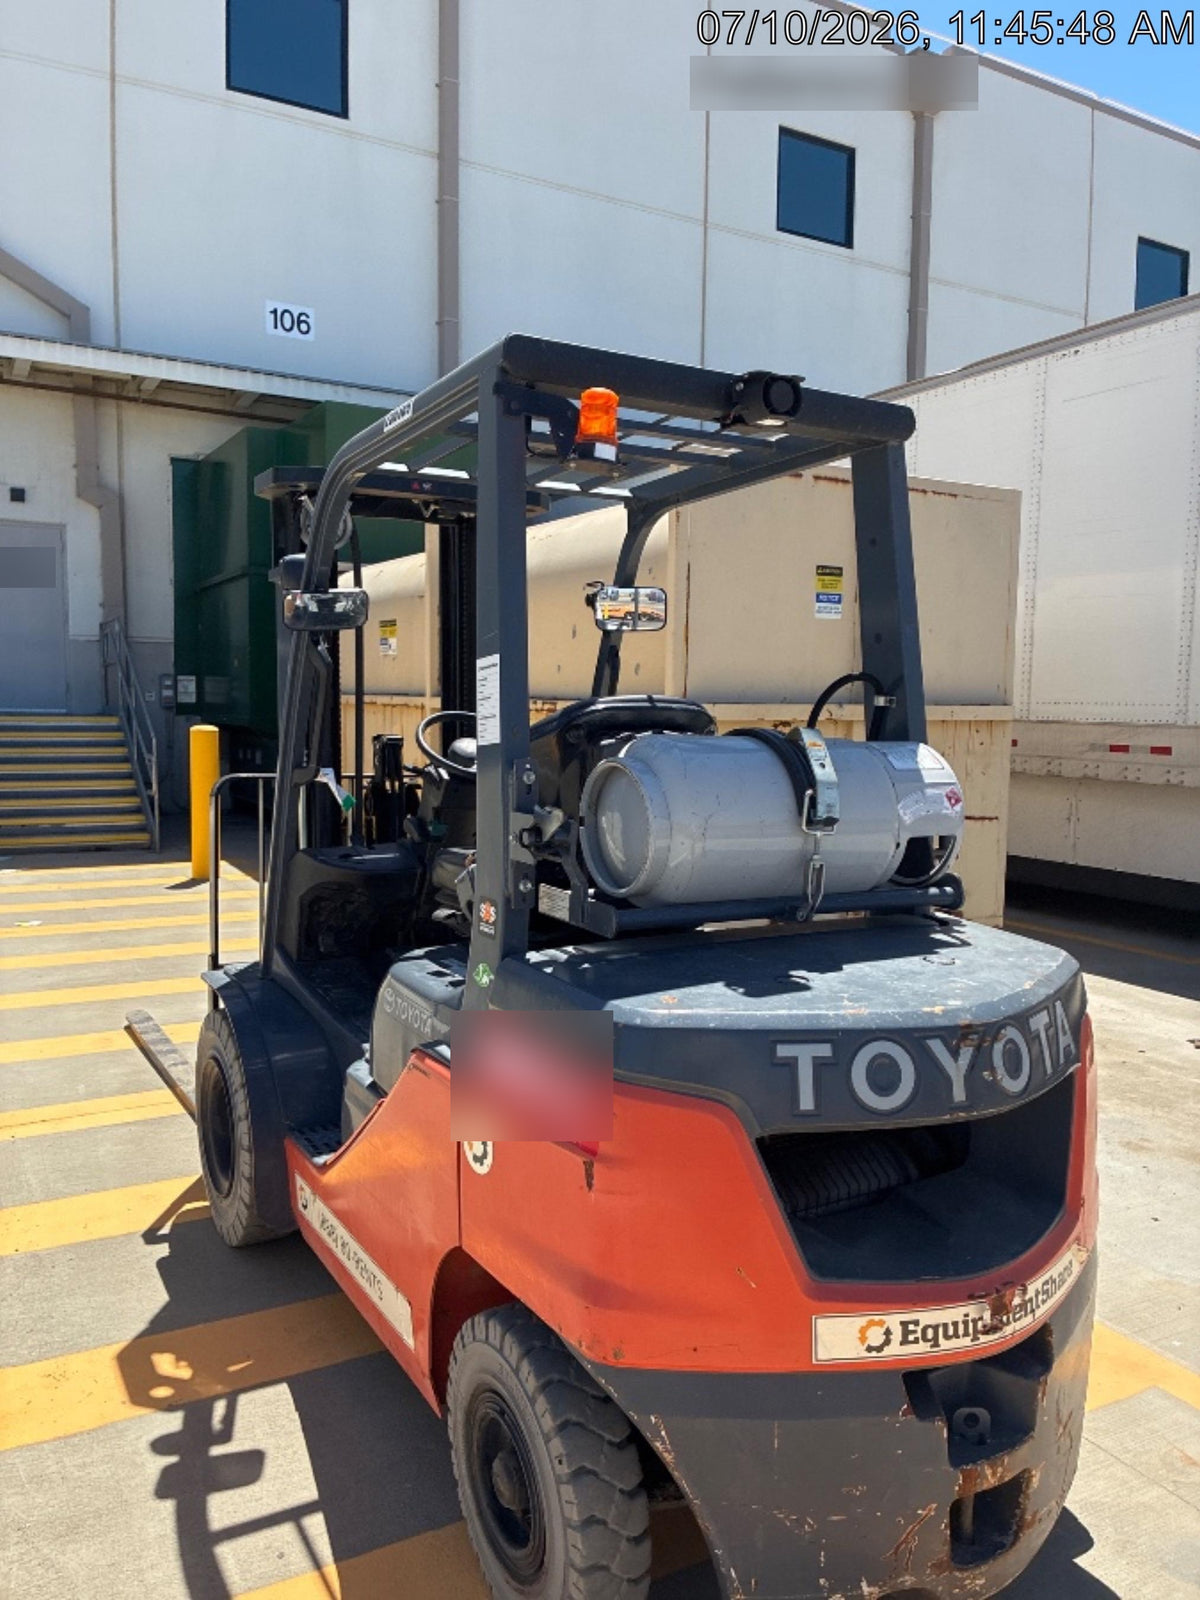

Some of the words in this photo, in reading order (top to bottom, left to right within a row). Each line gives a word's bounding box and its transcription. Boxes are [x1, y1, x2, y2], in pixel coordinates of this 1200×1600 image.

[269, 307, 311, 335] 106
[396, 997, 432, 1037] TOYOTA
[776, 1000, 1076, 1111] TOYOTA
[899, 1258, 1074, 1348] EquipentShare
